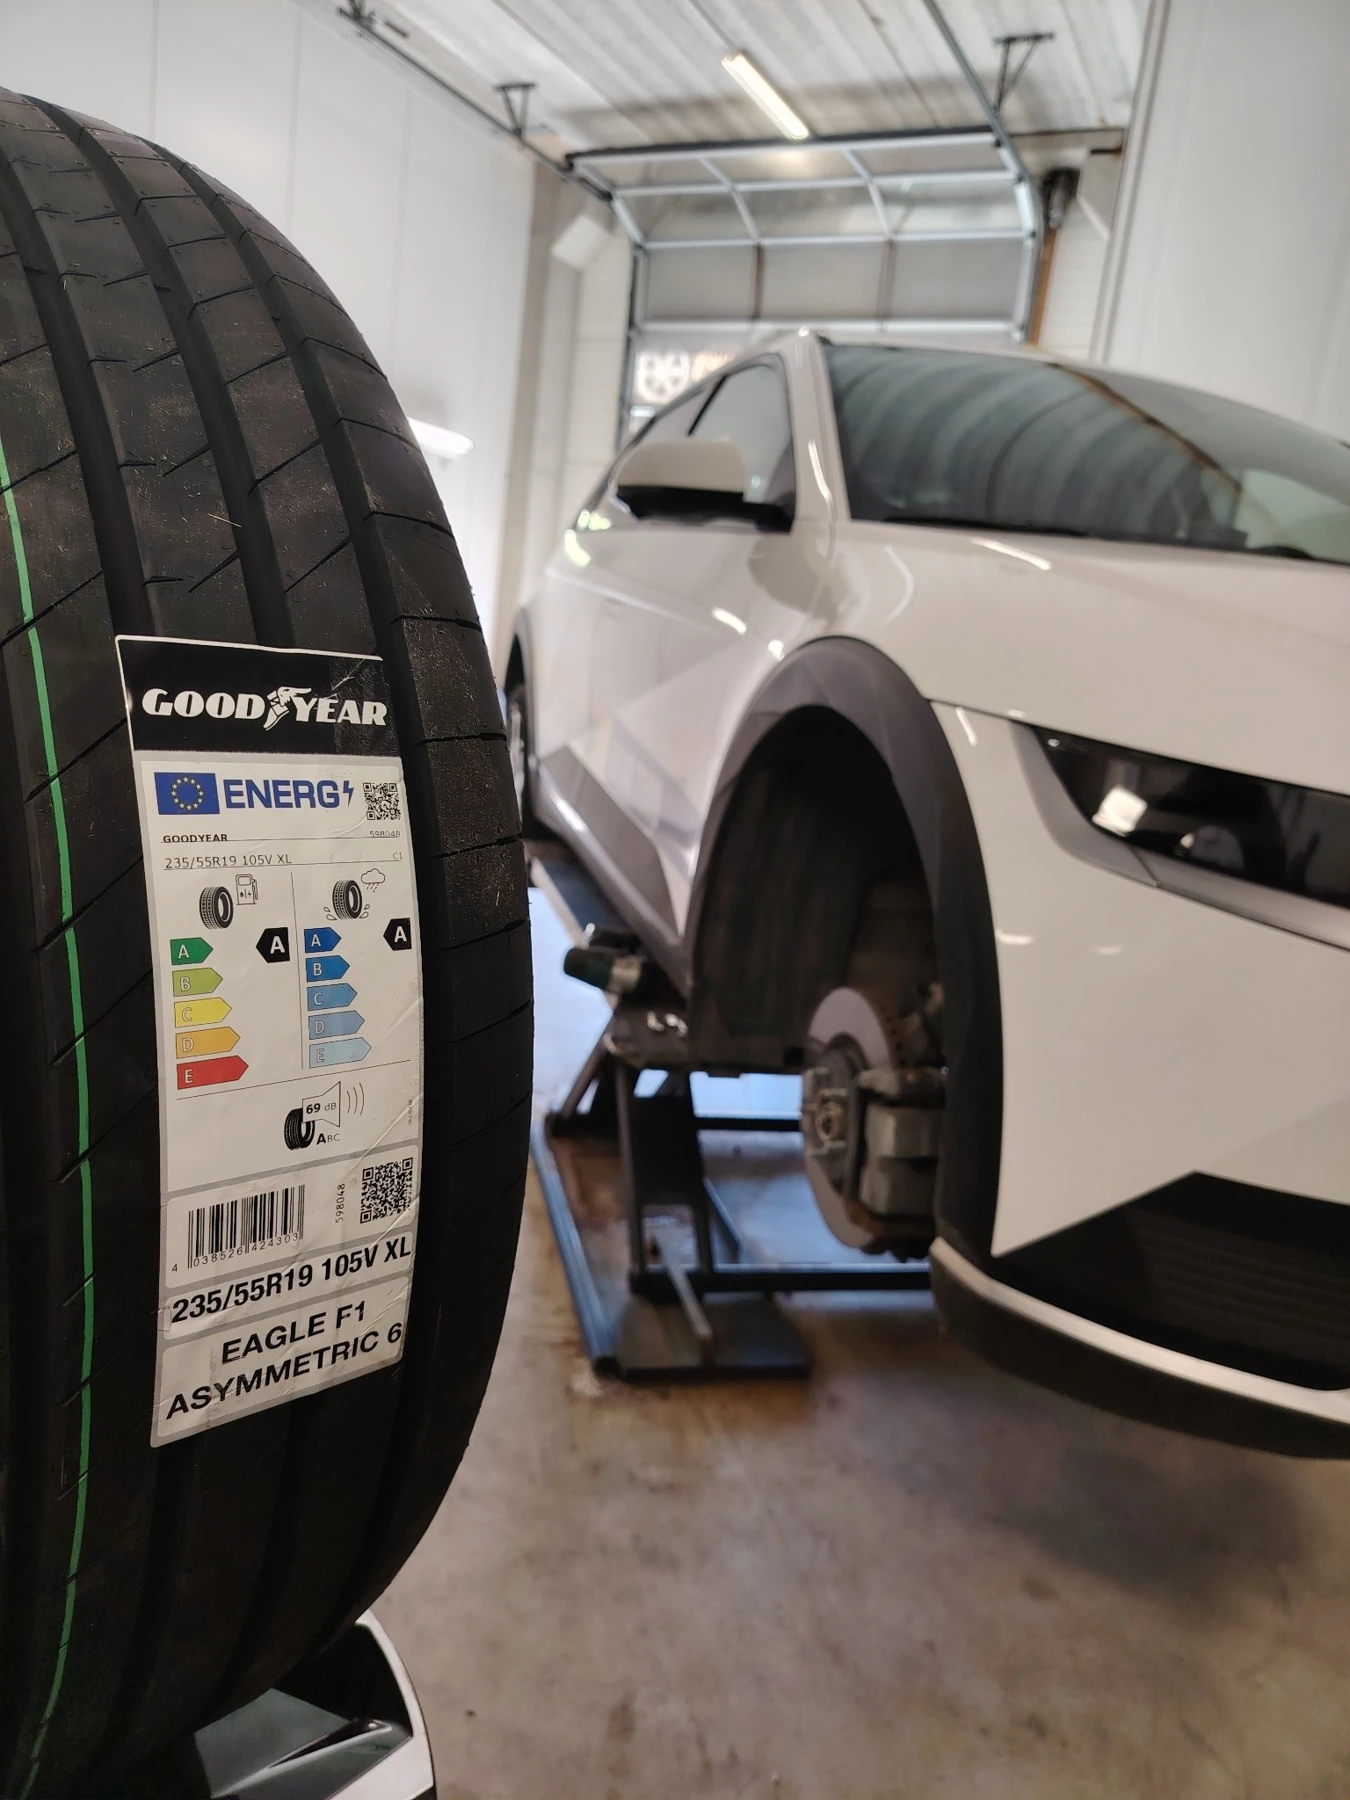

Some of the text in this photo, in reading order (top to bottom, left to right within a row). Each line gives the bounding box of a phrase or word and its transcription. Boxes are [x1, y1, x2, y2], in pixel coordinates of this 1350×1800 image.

[142, 687, 388, 727] GOODYEAR
[163, 833, 228, 844] GOODYEAR
[165, 852, 403, 869] 235/55R19 105V XL C1
[311, 934, 321, 947] A
[394, 926, 407, 942] A
[178, 945, 190, 959] A
[270, 935, 285, 954] A
[313, 963, 323, 976] B
[180, 976, 191, 992] B
[314, 992, 323, 1005] C
[182, 1007, 193, 1022] C
[315, 1020, 325, 1034] D
[182, 1037, 194, 1053] D
[316, 1048, 325, 1063] E
[184, 1068, 194, 1083] E
[306, 1102, 337, 1115] 69 dB
[316, 1133, 340, 1145] ABC
[335, 1183, 346, 1223] 598048
[171, 1263, 178, 1272] 4
[251, 1232, 299, 1252] 424303
[172, 1236, 411, 1323] 235/55R19 105V XL
[222, 1301, 365, 1365] EAGLE F1
[166, 1323, 402, 1420] ASYMMETRIC 6
